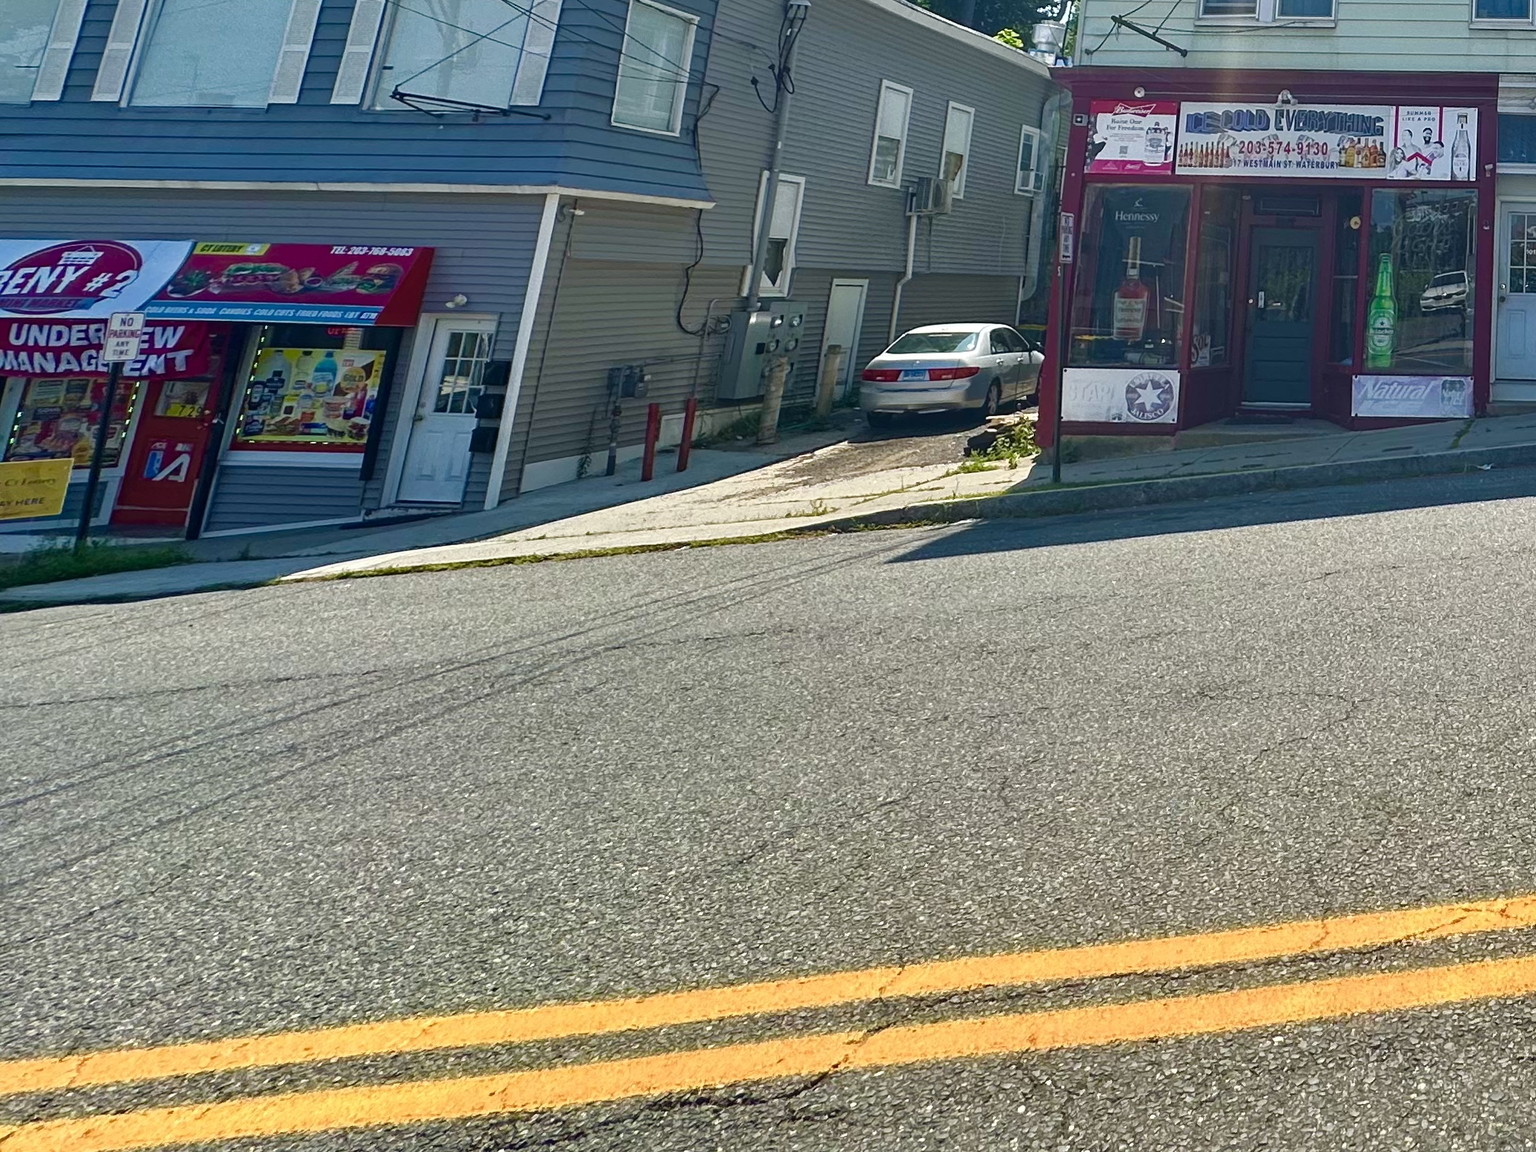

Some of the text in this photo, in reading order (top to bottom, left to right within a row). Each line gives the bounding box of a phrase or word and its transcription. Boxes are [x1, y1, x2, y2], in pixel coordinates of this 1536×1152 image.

[1186, 109, 1385, 137] ICE COLD EVERYTHING
[1239, 140, 1329, 156] 203-574-9130
[1115, 210, 1160, 223] Hennessy
[83, 270, 140, 297] #2
[120, 317, 134, 327] NO
[8, 323, 105, 346] UNDER
[109, 329, 140, 338] PARKING
[0, 349, 194, 376] MANAGEENT
[1359, 381, 1434, 400] Natural
[1131, 408, 1164, 419] JALISCO
[14, 496, 46, 506] HERE
